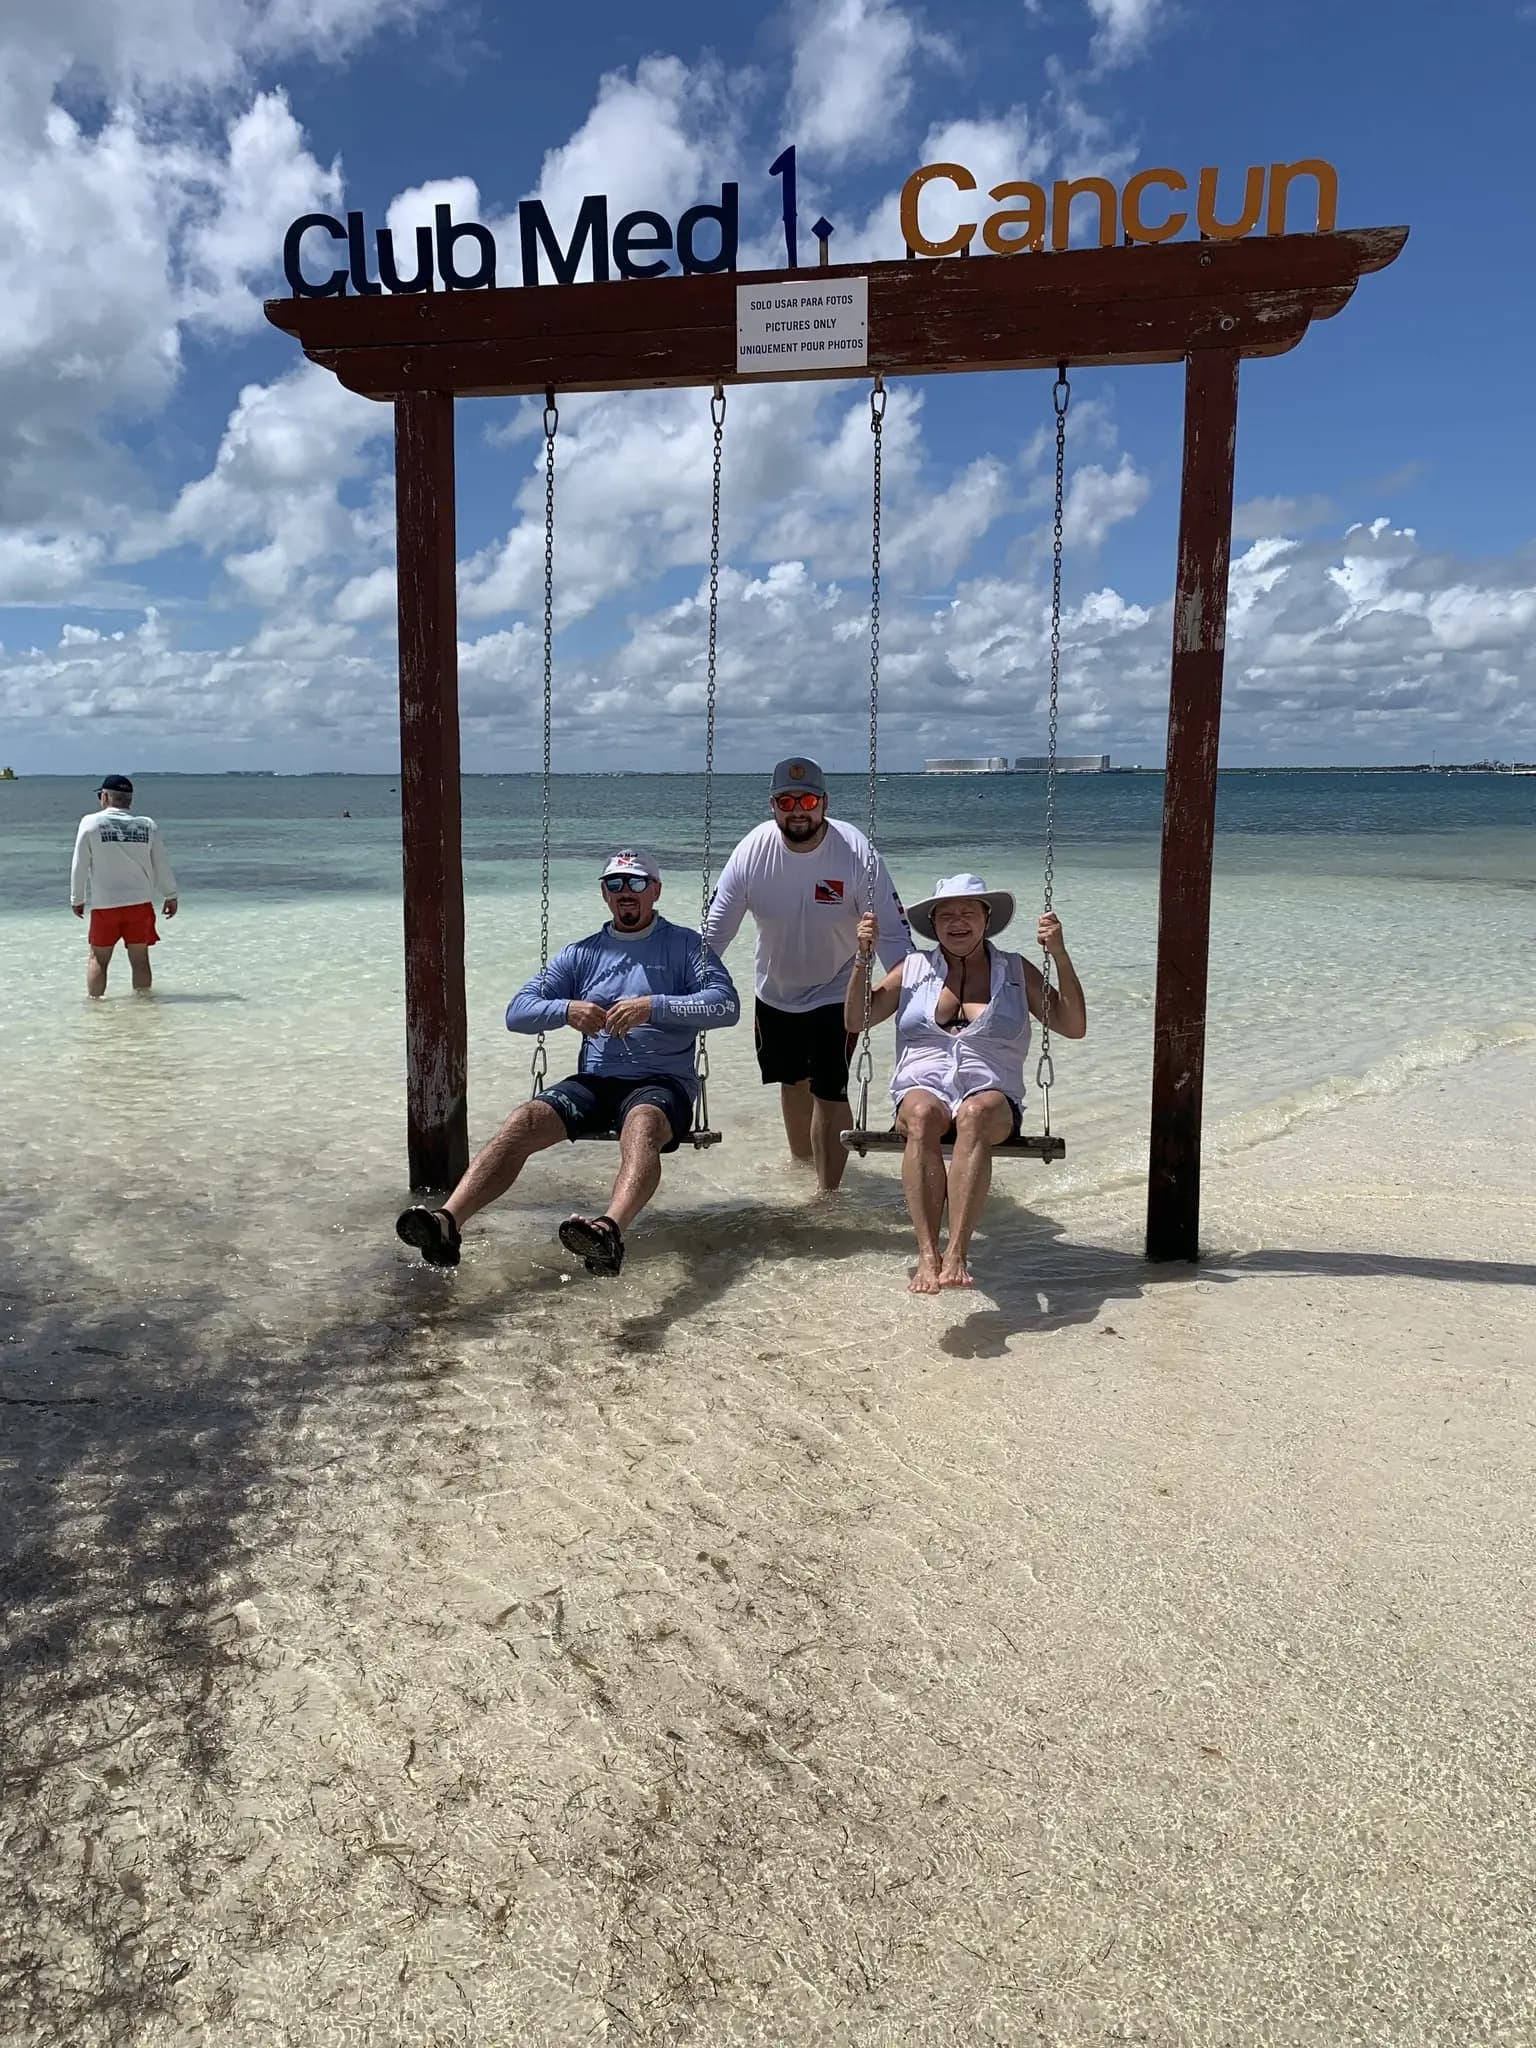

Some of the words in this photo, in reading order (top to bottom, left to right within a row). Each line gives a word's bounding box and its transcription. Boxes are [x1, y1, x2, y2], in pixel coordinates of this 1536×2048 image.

[900, 159, 1339, 257] Cancun
[283, 204, 496, 299] Club
[519, 182, 739, 288] Med
[750, 300, 772, 311] SOLO
[774, 298, 798, 309] USAR
[800, 296, 823, 308] PARA
[826, 294, 853, 306] FOTOS
[765, 320, 811, 333] PICTURES
[813, 318, 837, 329] ONLY
[739, 342, 798, 355] UNIQUEMENT
[800, 340, 825, 352] POUR
[827, 338, 864, 350] PHOTOS
[670, 1003, 726, 1016] Columbia
